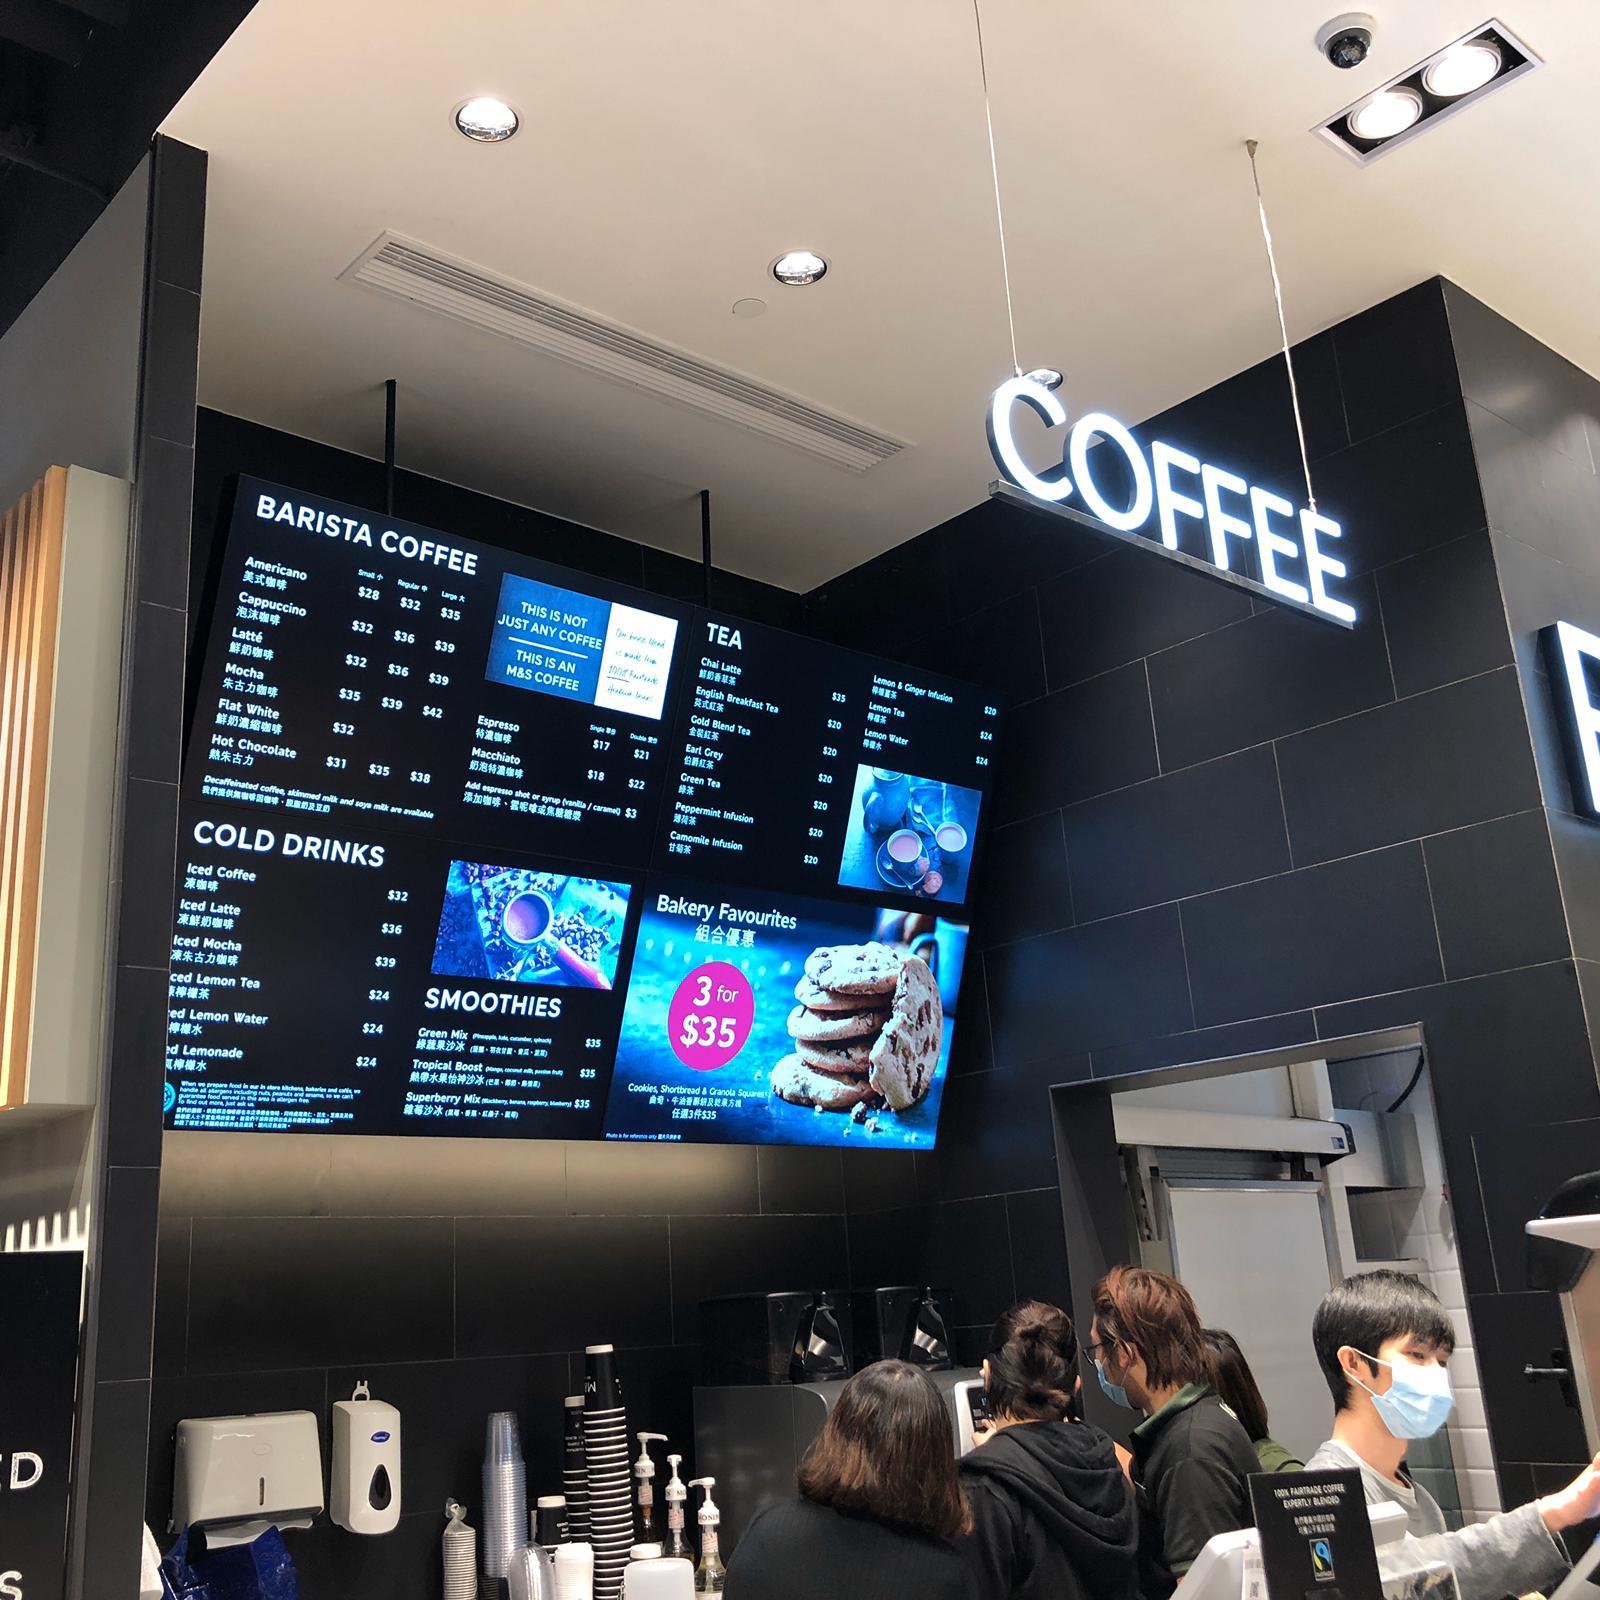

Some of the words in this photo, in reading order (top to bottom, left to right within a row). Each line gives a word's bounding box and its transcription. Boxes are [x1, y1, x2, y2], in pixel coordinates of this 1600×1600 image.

[986, 376, 1356, 622] COFFEE
[256, 494, 372, 547] BARISTA
[381, 530, 478, 575] COFFEE
[245, 556, 308, 581] Americano
[243, 570, 287, 591] 美式咖啡
[398, 579, 420, 591] Regular
[238, 591, 306, 617] Cappuccino
[358, 586, 380, 600] $28
[400, 597, 421, 611] $32
[441, 607, 461, 621] $35
[441, 590, 457, 601] Large
[521, 602, 547, 620] THIS
[550, 608, 561, 621] IS
[564, 611, 588, 628] NOT
[232, 627, 263, 644] Latté
[352, 620, 373, 634] $32
[394, 630, 415, 644] $36
[434, 640, 455, 653] $39
[498, 614, 529, 633] JUST
[531, 622, 557, 638] ANY
[559, 627, 602, 650] COFFEE
[706, 622, 742, 650] TEA
[229, 641, 274, 661] 鮮奶咖啡
[346, 654, 367, 668] $32
[388, 664, 409, 677] $36
[428, 673, 449, 686] $39
[516, 650, 542, 667] THIS
[545, 655, 556, 669] IS
[558, 658, 575, 673] AN
[701, 657, 719, 669] Chai
[722, 662, 742, 675] Latte
[225, 662, 264, 680] Mocha
[506, 665, 533, 682] M&S
[535, 671, 580, 692] COFFEE
[222, 677, 279, 699] 朱古力咖啡
[873, 675, 895, 688] Lemon
[897, 681, 903, 689] &
[905, 683, 926, 696] Ginger
[928, 689, 953, 703] Infusion
[339, 688, 361, 701] $35
[382, 697, 403, 710] $39
[423, 705, 443, 719] $42
[696, 686, 725, 701] English
[727, 693, 764, 711] Breakfast
[766, 702, 779, 714] Tea
[832, 692, 846, 703] $35
[218, 699, 242, 712] Flat
[246, 703, 280, 720] White
[869, 701, 891, 715] Lemon
[893, 707, 905, 718] Tea
[984, 706, 997, 716] $20
[333, 722, 354, 735] $32
[478, 715, 520, 733] Espresso
[590, 725, 605, 734] Single
[691, 715, 710, 728] Gold
[712, 720, 735, 734] Blend
[737, 725, 751, 736] Tea
[828, 719, 842, 730] $20
[864, 728, 887, 740] Lemon
[889, 734, 909, 746] Water
[980, 731, 992, 741] $24
[211, 734, 234, 748] Hot
[238, 738, 297, 759] Chocolate
[593, 739, 610, 751] $17
[634, 749, 650, 761] $21
[686, 744, 703, 756] Earl
[704, 748, 723, 761] Grey
[823, 746, 837, 757] $20
[209, 748, 254, 767] 熱朱古力
[471, 747, 520, 765] Macchiato
[976, 756, 988, 766] $24
[326, 756, 347, 769] $31
[369, 763, 390, 776] $35
[410, 771, 431, 784] $38
[818, 773, 832, 784] $20
[588, 769, 604, 781] $18
[628, 778, 645, 790] $22
[680, 773, 704, 786] Green
[707, 778, 721, 789] Tea
[204, 775, 258, 790] Decaffeinated
[260, 783, 286, 796] coffee,
[288, 788, 321, 800] skimmed
[322, 793, 338, 804] milk
[340, 796, 354, 806] and
[355, 800, 372, 810] soya
[373, 802, 389, 811] milk
[390, 806, 402, 814] are
[403, 807, 434, 819] available
[465, 781, 480, 791] Add
[482, 785, 513, 796] espresso
[515, 790, 531, 799] shot
[541, 795, 560, 805] syrup
[625, 808, 637, 819] $3
[813, 800, 828, 811] $20
[675, 802, 721, 819] Peppermint
[723, 810, 753, 824] Infusion
[670, 831, 709, 846] Camomile
[712, 837, 743, 851] Infusion
[809, 827, 823, 837] $20
[194, 821, 275, 852] COLD
[282, 833, 385, 867] DRINKS
[804, 854, 818, 865] $20
[187, 863, 213, 876] Iced
[217, 866, 256, 882] Coffee
[388, 889, 408, 902] $32
[180, 899, 206, 912] Iced
[210, 902, 241, 916] Latte
[657, 894, 714, 922] Bakery
[719, 903, 797, 929] Favourites
[381, 923, 402, 935] $36
[694, 924, 756, 947] 組合優惠
[173, 935, 199, 948] Iced
[203, 938, 242, 951] Mocha
[375, 956, 396, 968] $39
[170, 973, 192, 983] ced
[196, 975, 235, 987] Lemon
[240, 977, 260, 989] Tea
[369, 989, 389, 1001] $24
[693, 976, 713, 1006] 3
[716, 985, 739, 1003] for
[424, 988, 562, 1018] SMOOTHIES
[189, 1010, 229, 1022] Lemon
[234, 1012, 268, 1024] Water
[362, 1022, 383, 1034] $24
[418, 1028, 448, 1039] Green
[451, 1029, 468, 1040] Mix
[680, 1013, 736, 1048] $35
[585, 1038, 601, 1048] $35
[182, 1046, 243, 1059] Lemonade
[356, 1056, 377, 1067] $24
[412, 1059, 451, 1071] Tropical
[455, 1061, 483, 1072] Boost
[580, 1069, 595, 1078] $35
[406, 1092, 461, 1105] Superberry
[464, 1094, 480, 1104] Mix
[628, 1083, 658, 1093] Cookies,
[660, 1084, 700, 1095] Shortbread
[702, 1087, 707, 1095] &
[709, 1087, 735, 1097] Granola
[574, 1100, 590, 1108] $35
[1290, 1485, 1322, 1496] FAIRTRADE
[1323, 1484, 1345, 1493] COFFEE
[1313, 1495, 1339, 1506] BLENDED
